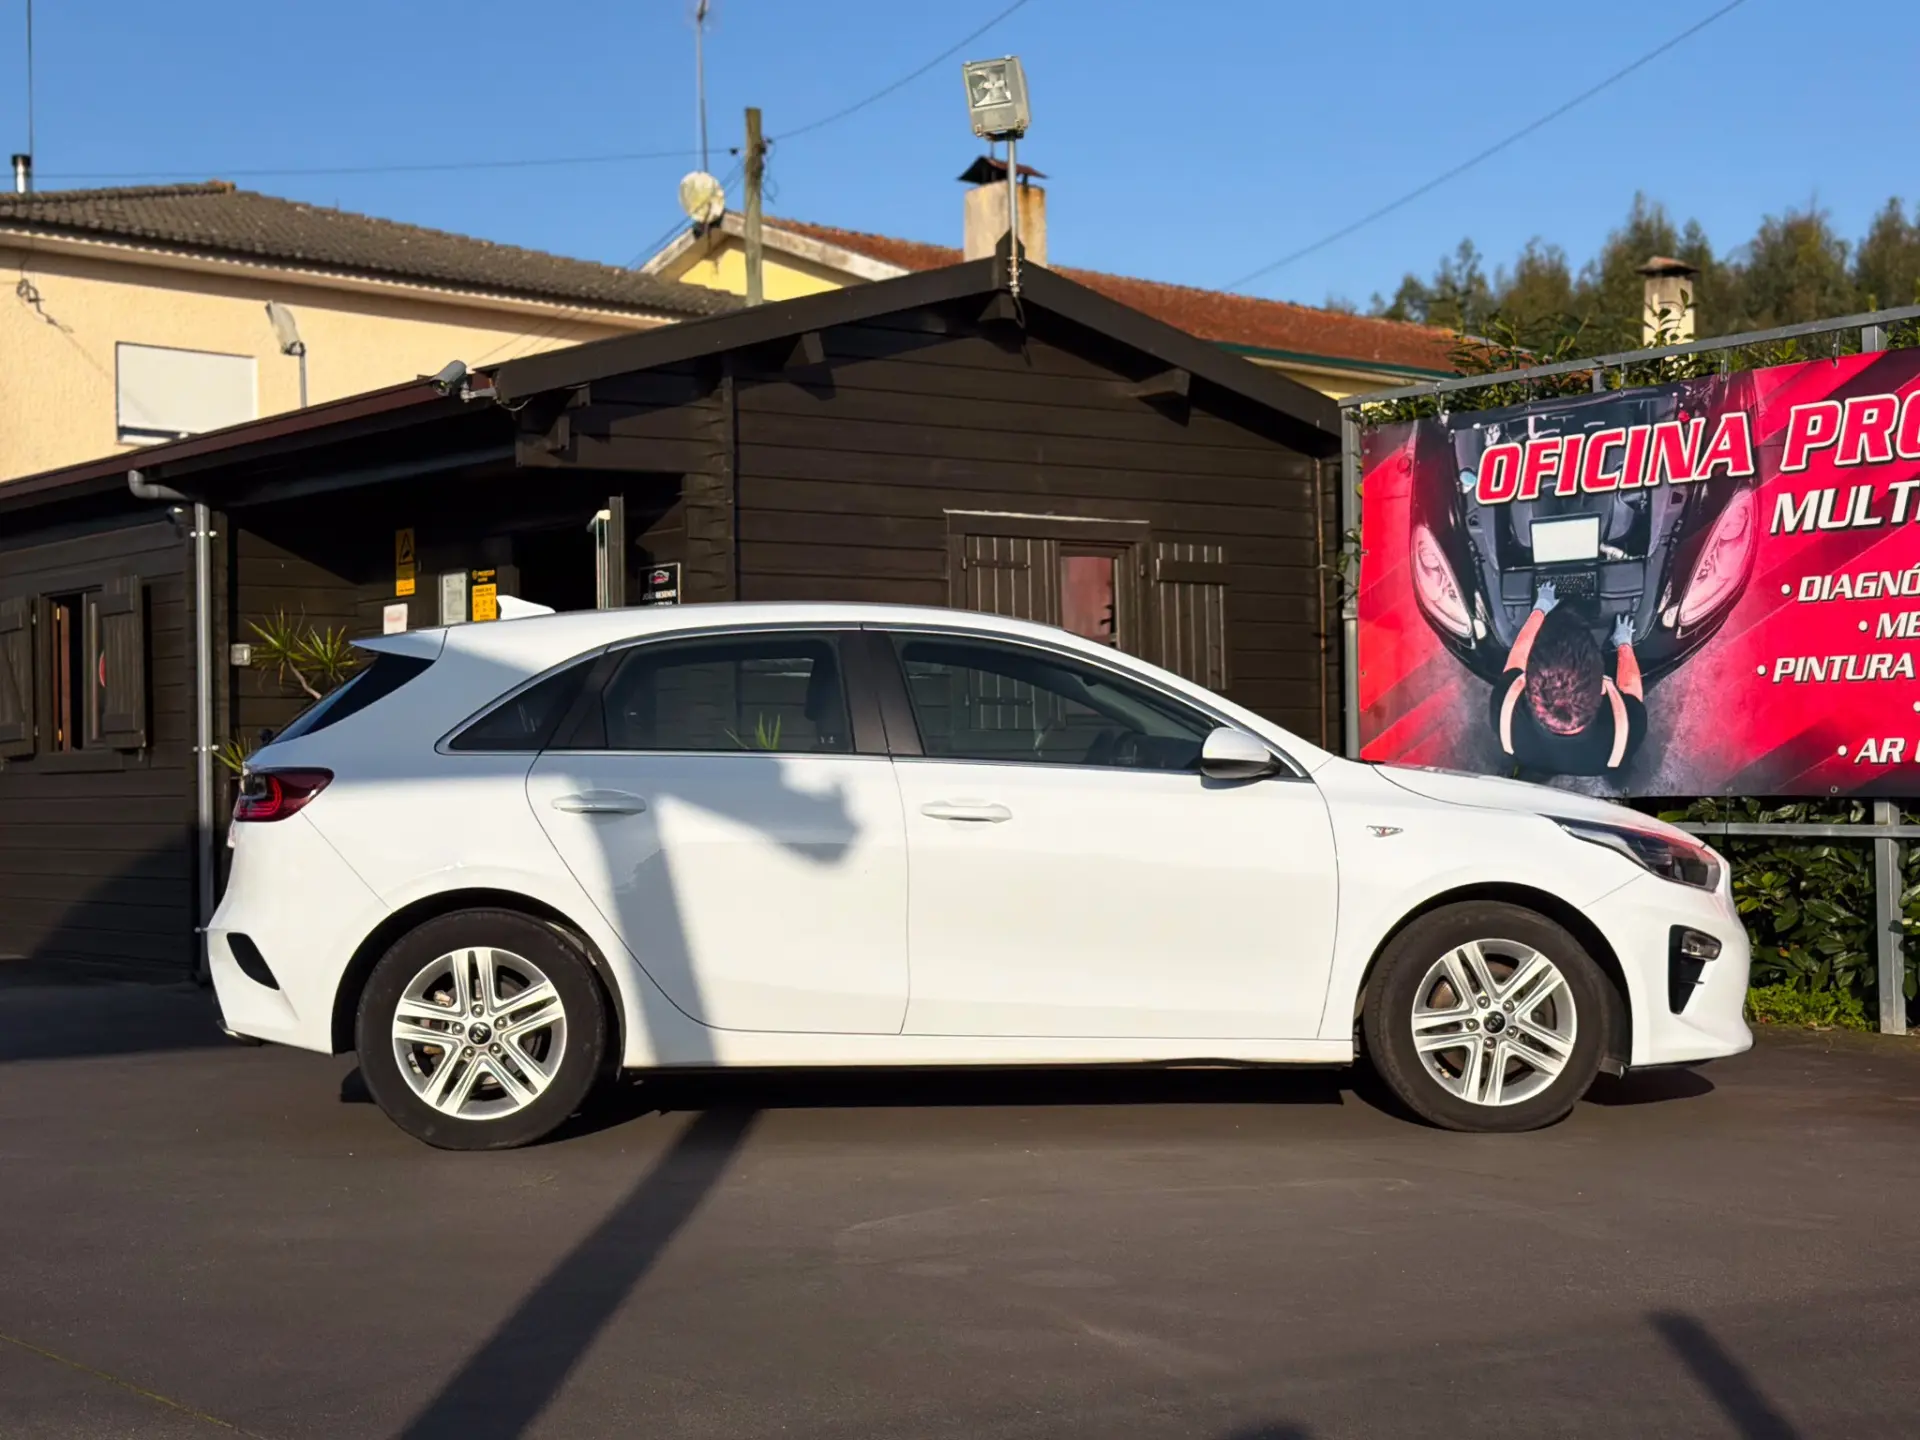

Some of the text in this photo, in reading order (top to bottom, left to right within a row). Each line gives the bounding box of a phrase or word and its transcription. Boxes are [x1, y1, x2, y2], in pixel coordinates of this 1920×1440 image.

[1475, 411, 1754, 504] OFICINA
[1770, 480, 1920, 533] MULT
[1797, 561, 1920, 602] DIAGNÓ
[1772, 652, 1915, 683] PINTURA
[1854, 737, 1905, 764] AR
